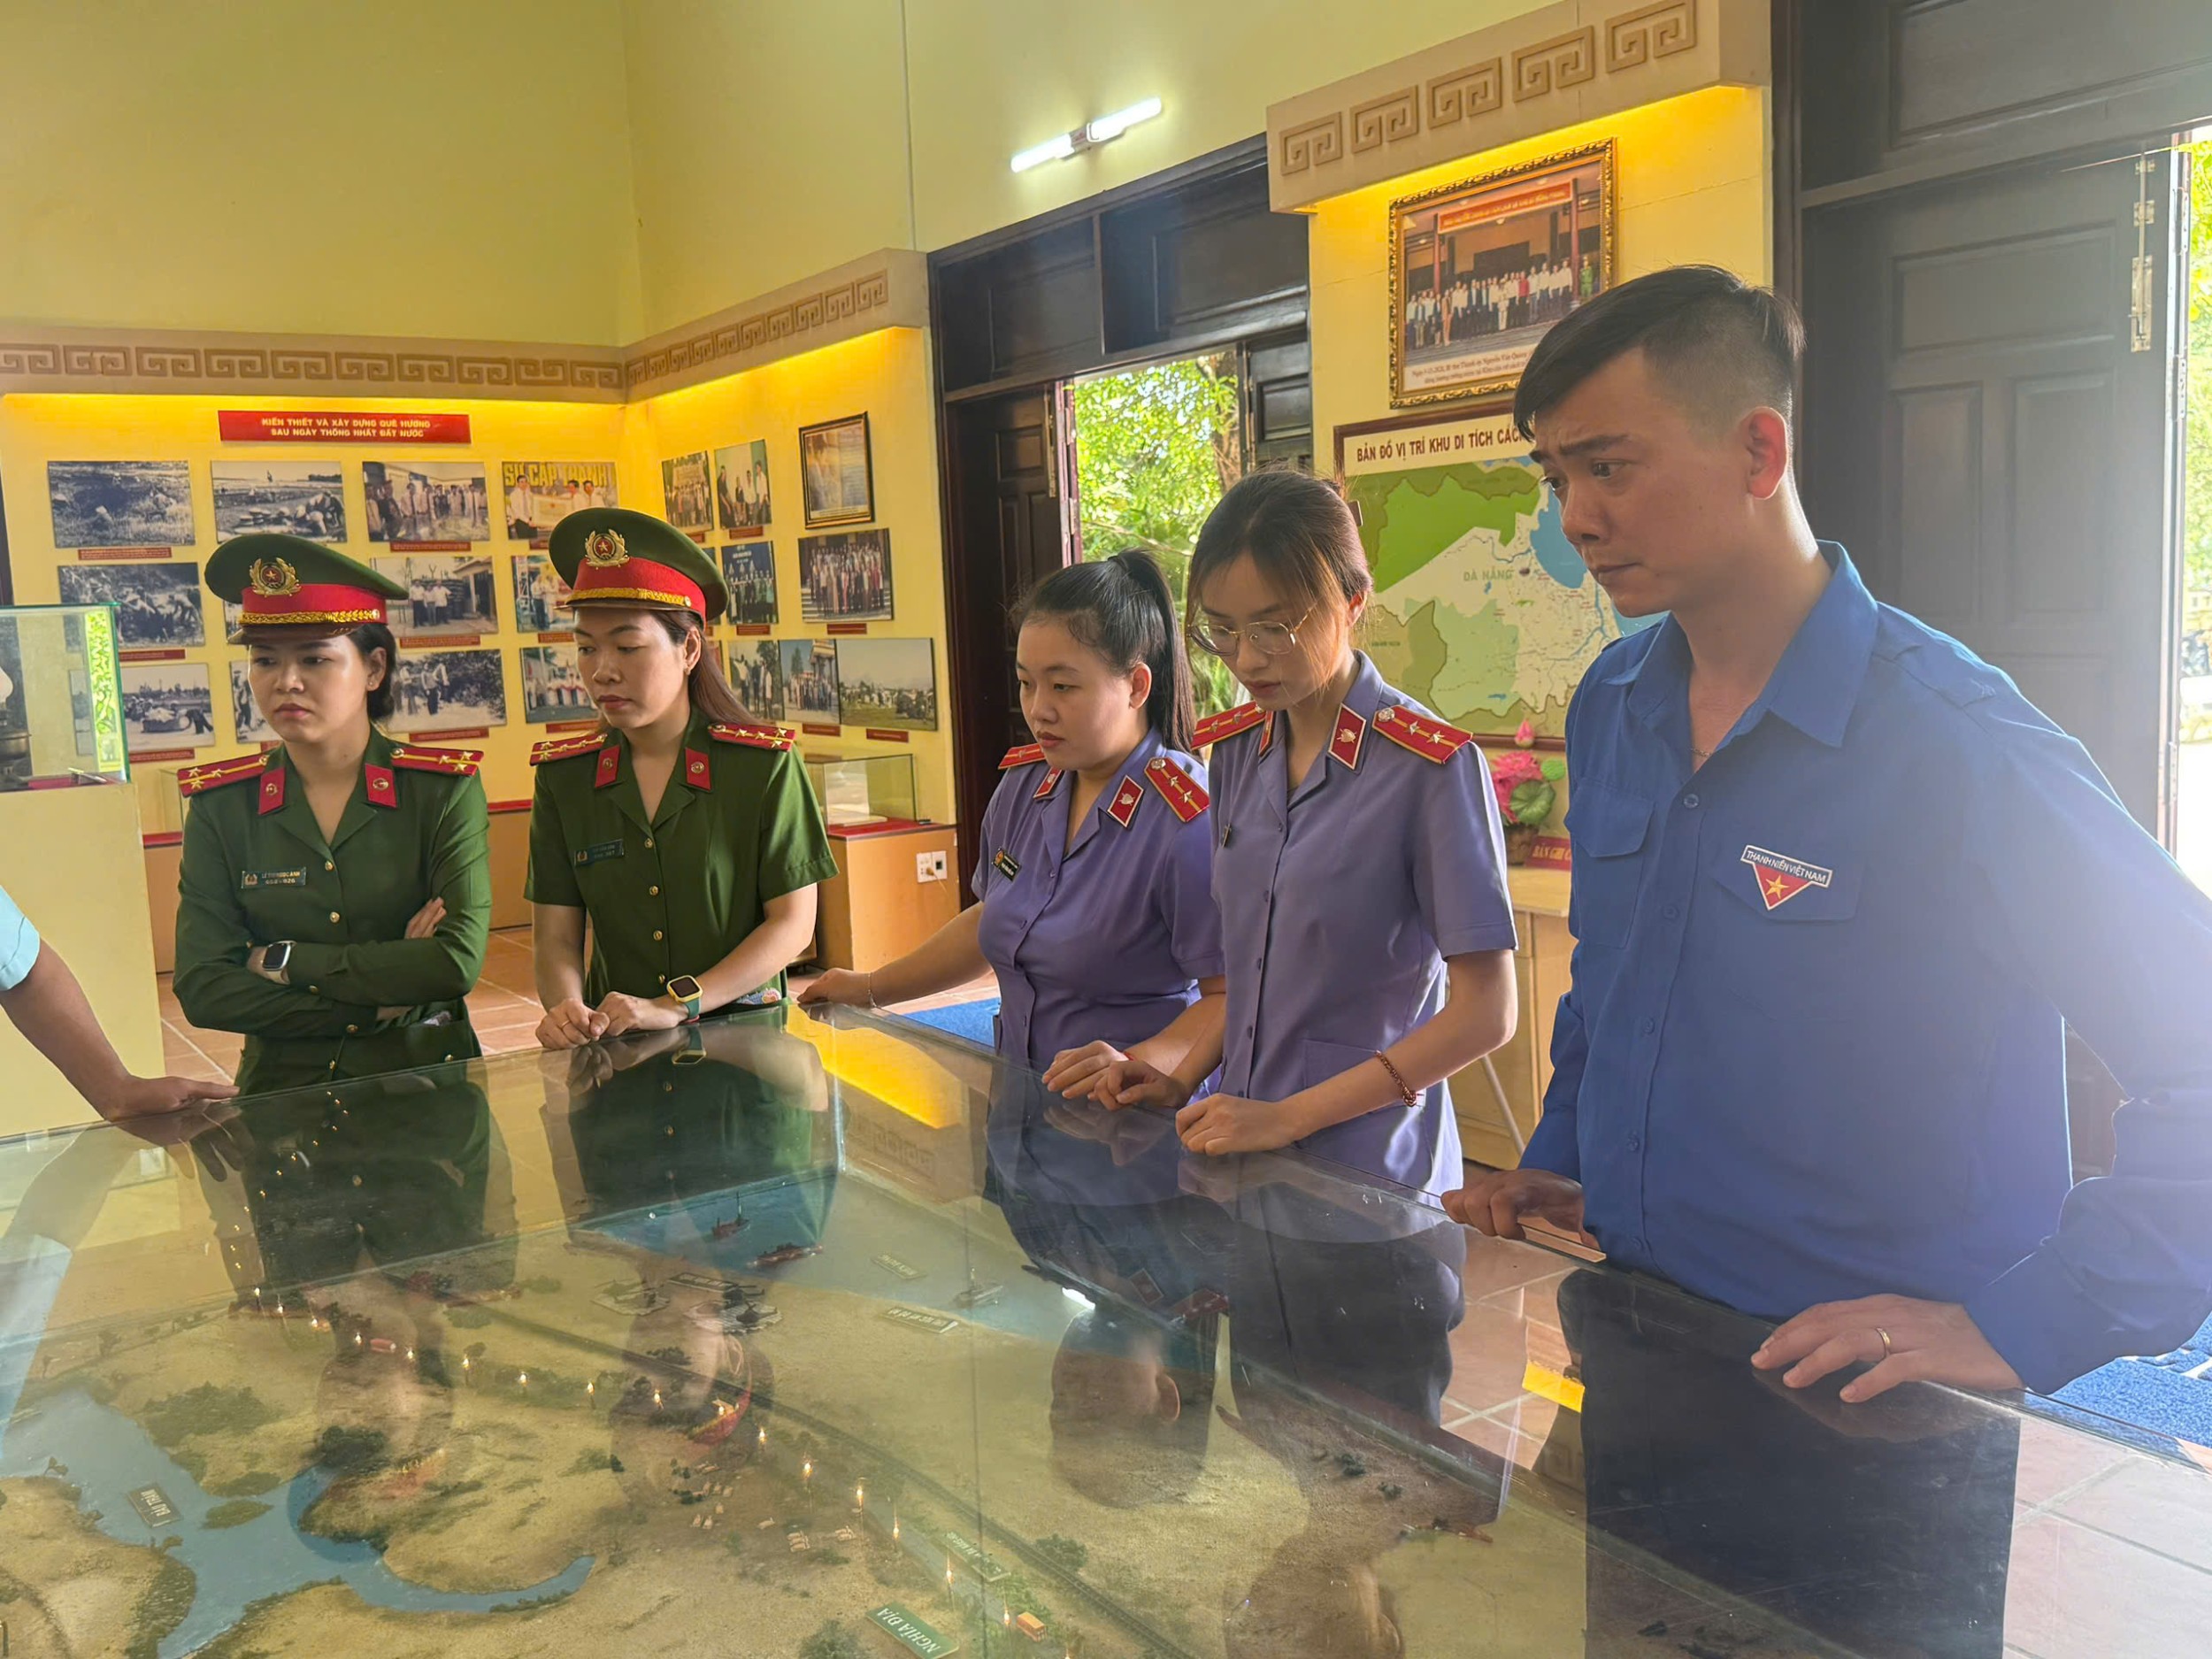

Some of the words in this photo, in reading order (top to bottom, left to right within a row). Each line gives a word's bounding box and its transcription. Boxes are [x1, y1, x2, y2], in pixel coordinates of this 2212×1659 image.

[293, 427, 317, 436] NGÀY
[316, 418, 328, 426] VÀ
[1357, 443, 1376, 463] BẢN
[1379, 440, 1393, 459] ĐỒ
[1396, 442, 1407, 462] VỊ
[1410, 435, 1425, 455] TRÍ
[1429, 437, 1450, 453] KHU
[1455, 436, 1464, 449] DI
[1469, 428, 1493, 449] TÍCH
[1497, 424, 1522, 444] CÁC
[1747, 850, 1771, 866] THANH
[1770, 858, 1789, 872] NIÊN
[1789, 864, 1806, 877] VIỆT
[1805, 871, 1826, 884] NAM
[877, 1608, 904, 1626] ĐỊA
[897, 1623, 941, 1654] NGHĨA
